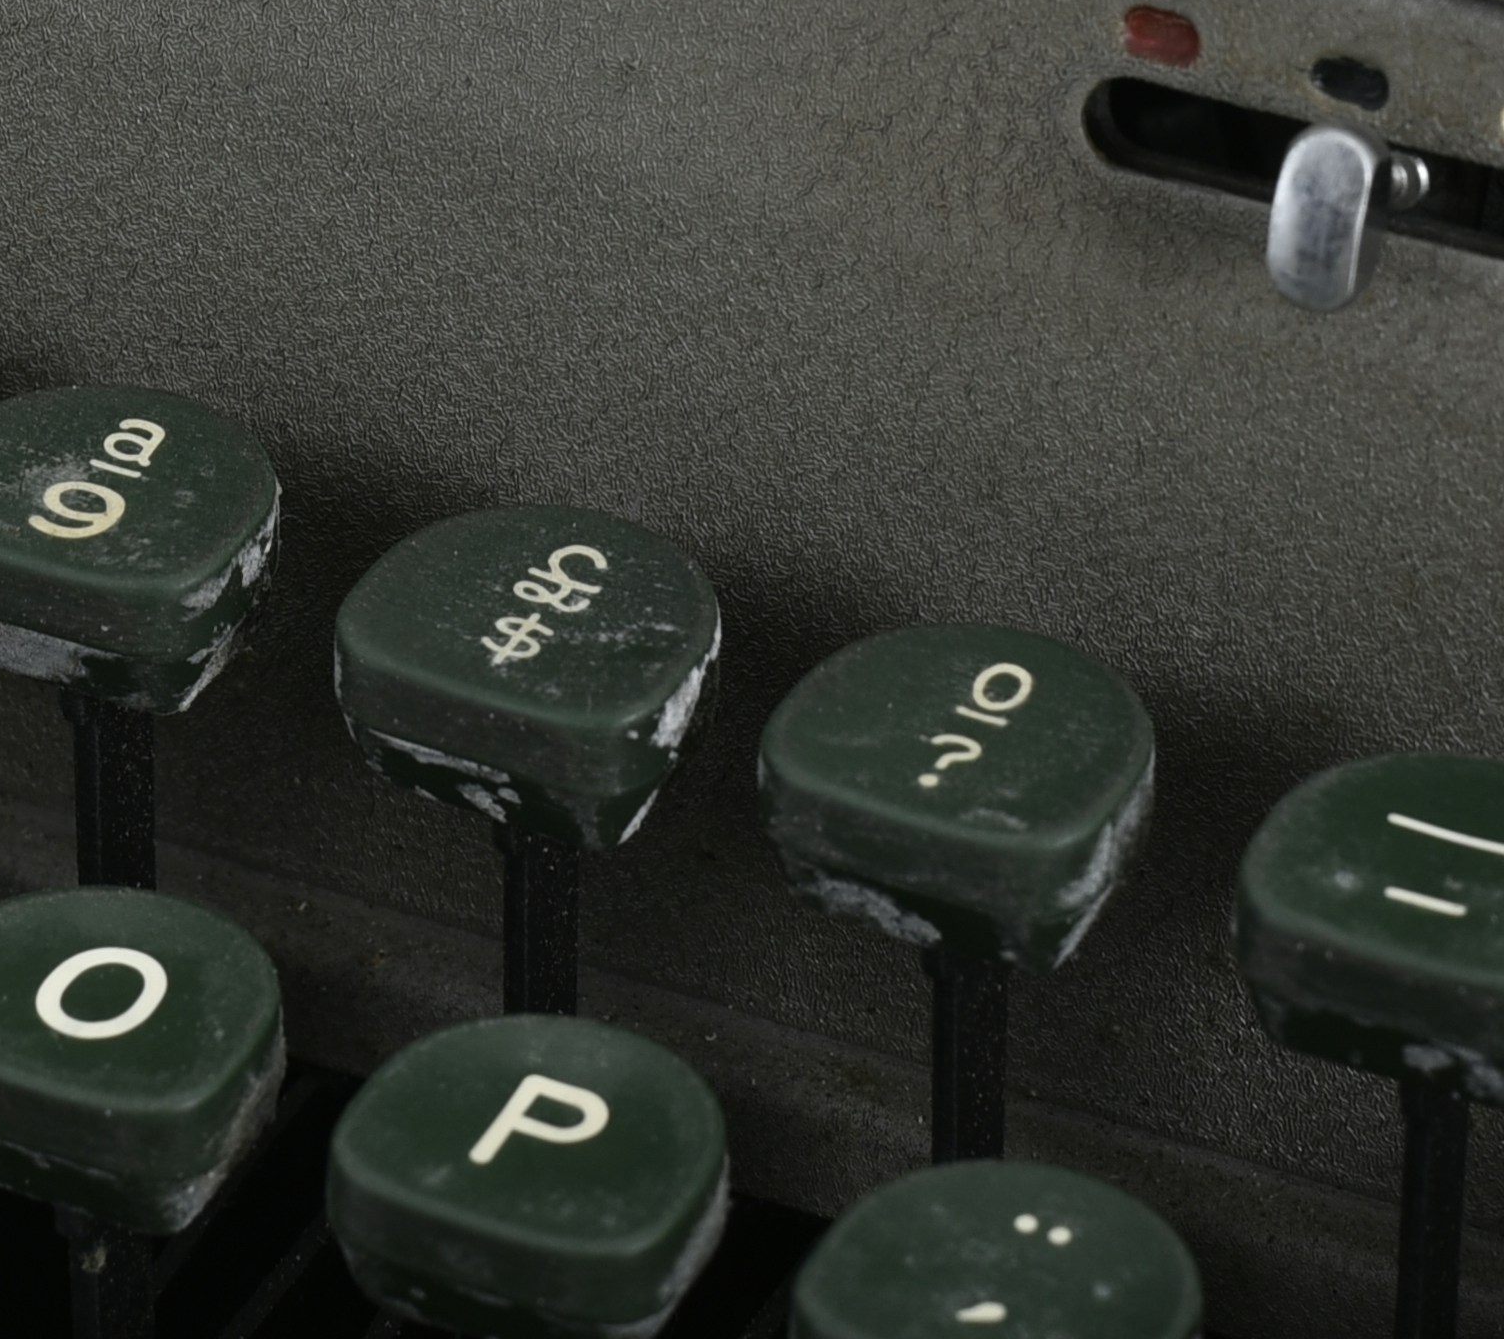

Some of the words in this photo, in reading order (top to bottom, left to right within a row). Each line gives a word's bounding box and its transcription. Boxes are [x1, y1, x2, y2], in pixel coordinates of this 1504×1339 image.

[27, 479, 127, 540] 9
[479, 611, 555, 667] $
[917, 733, 983, 789] ?
[34, 945, 169, 1041] O
[468, 1073, 610, 1165] P
